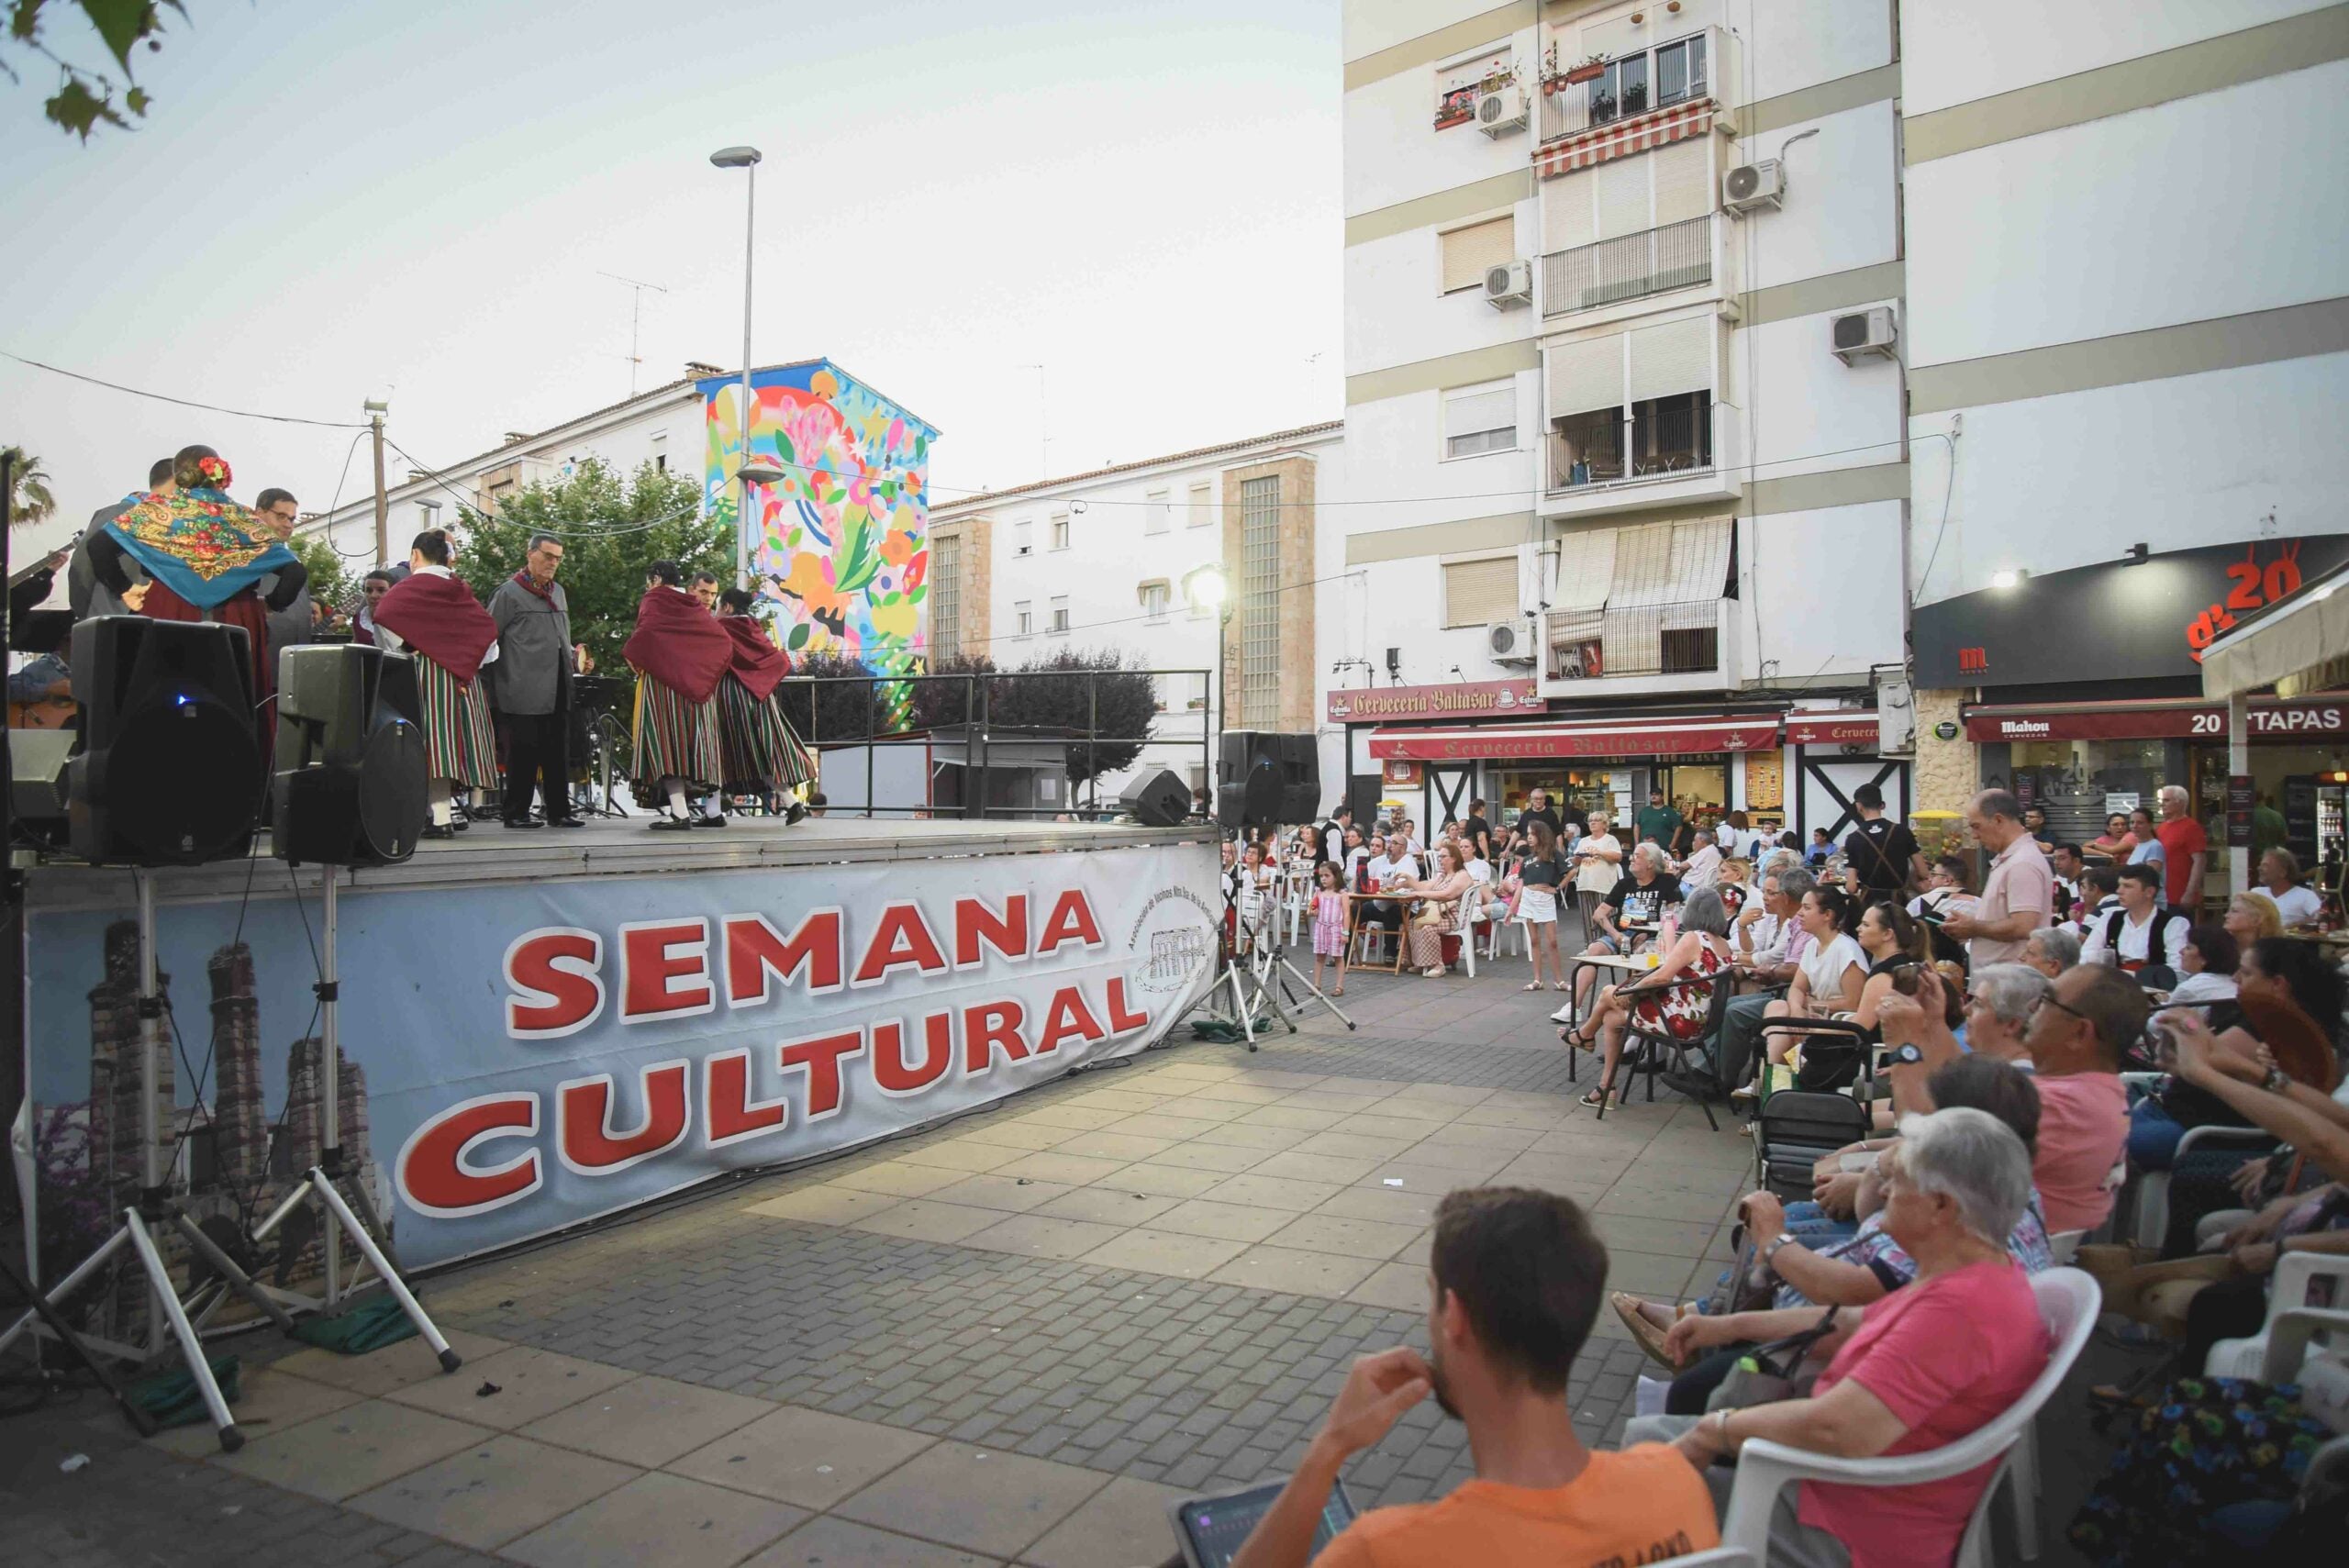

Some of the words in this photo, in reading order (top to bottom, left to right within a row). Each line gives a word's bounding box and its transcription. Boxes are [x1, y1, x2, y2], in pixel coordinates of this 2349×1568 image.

[1353, 691, 1428, 716] Cervecería
[1431, 689, 1497, 712] Baltasar
[2000, 720, 2050, 733] Mahou
[2190, 715, 2221, 733] 20
[2246, 708, 2342, 731] 'TAPAS
[510, 891, 1101, 1030] SEMANA
[404, 977, 1148, 1207] CULTURAL
